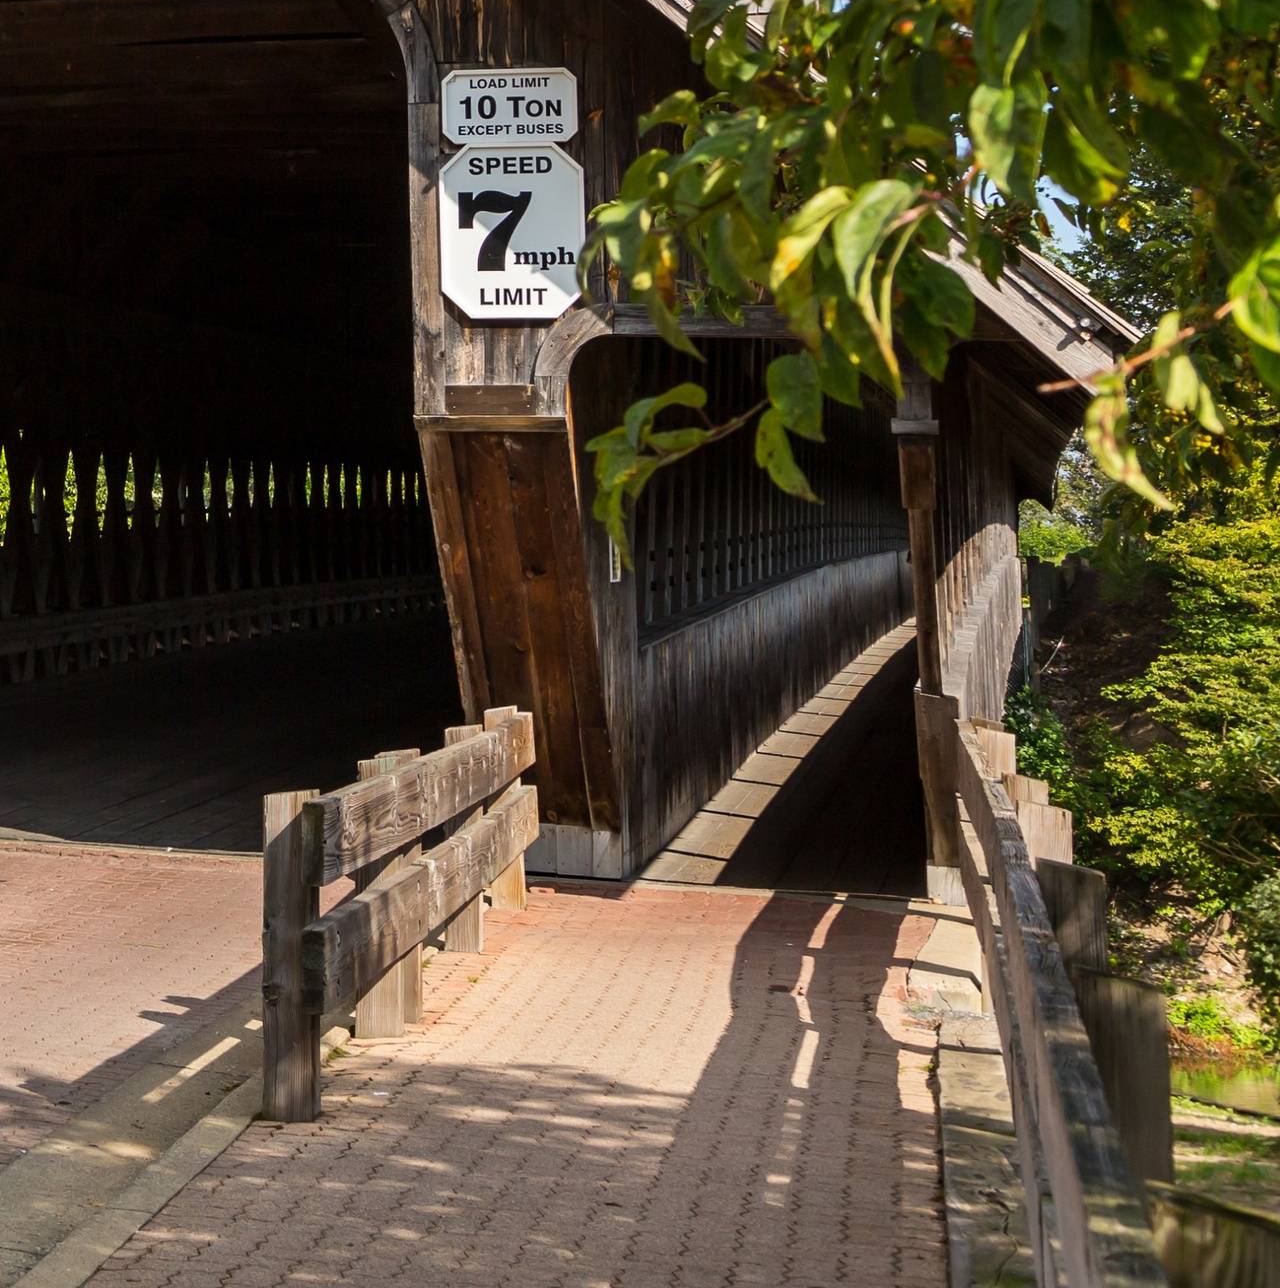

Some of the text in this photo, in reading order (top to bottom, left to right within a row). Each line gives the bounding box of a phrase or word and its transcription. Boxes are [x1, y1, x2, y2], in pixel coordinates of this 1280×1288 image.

[469, 77, 550, 89] LOAD LIMIT
[458, 94, 497, 120] 10
[457, 123, 564, 136] EXCEPT BUSES
[468, 155, 553, 176] SPEED
[458, 189, 577, 272] 7 mph
[479, 287, 548, 306] LIMIT
